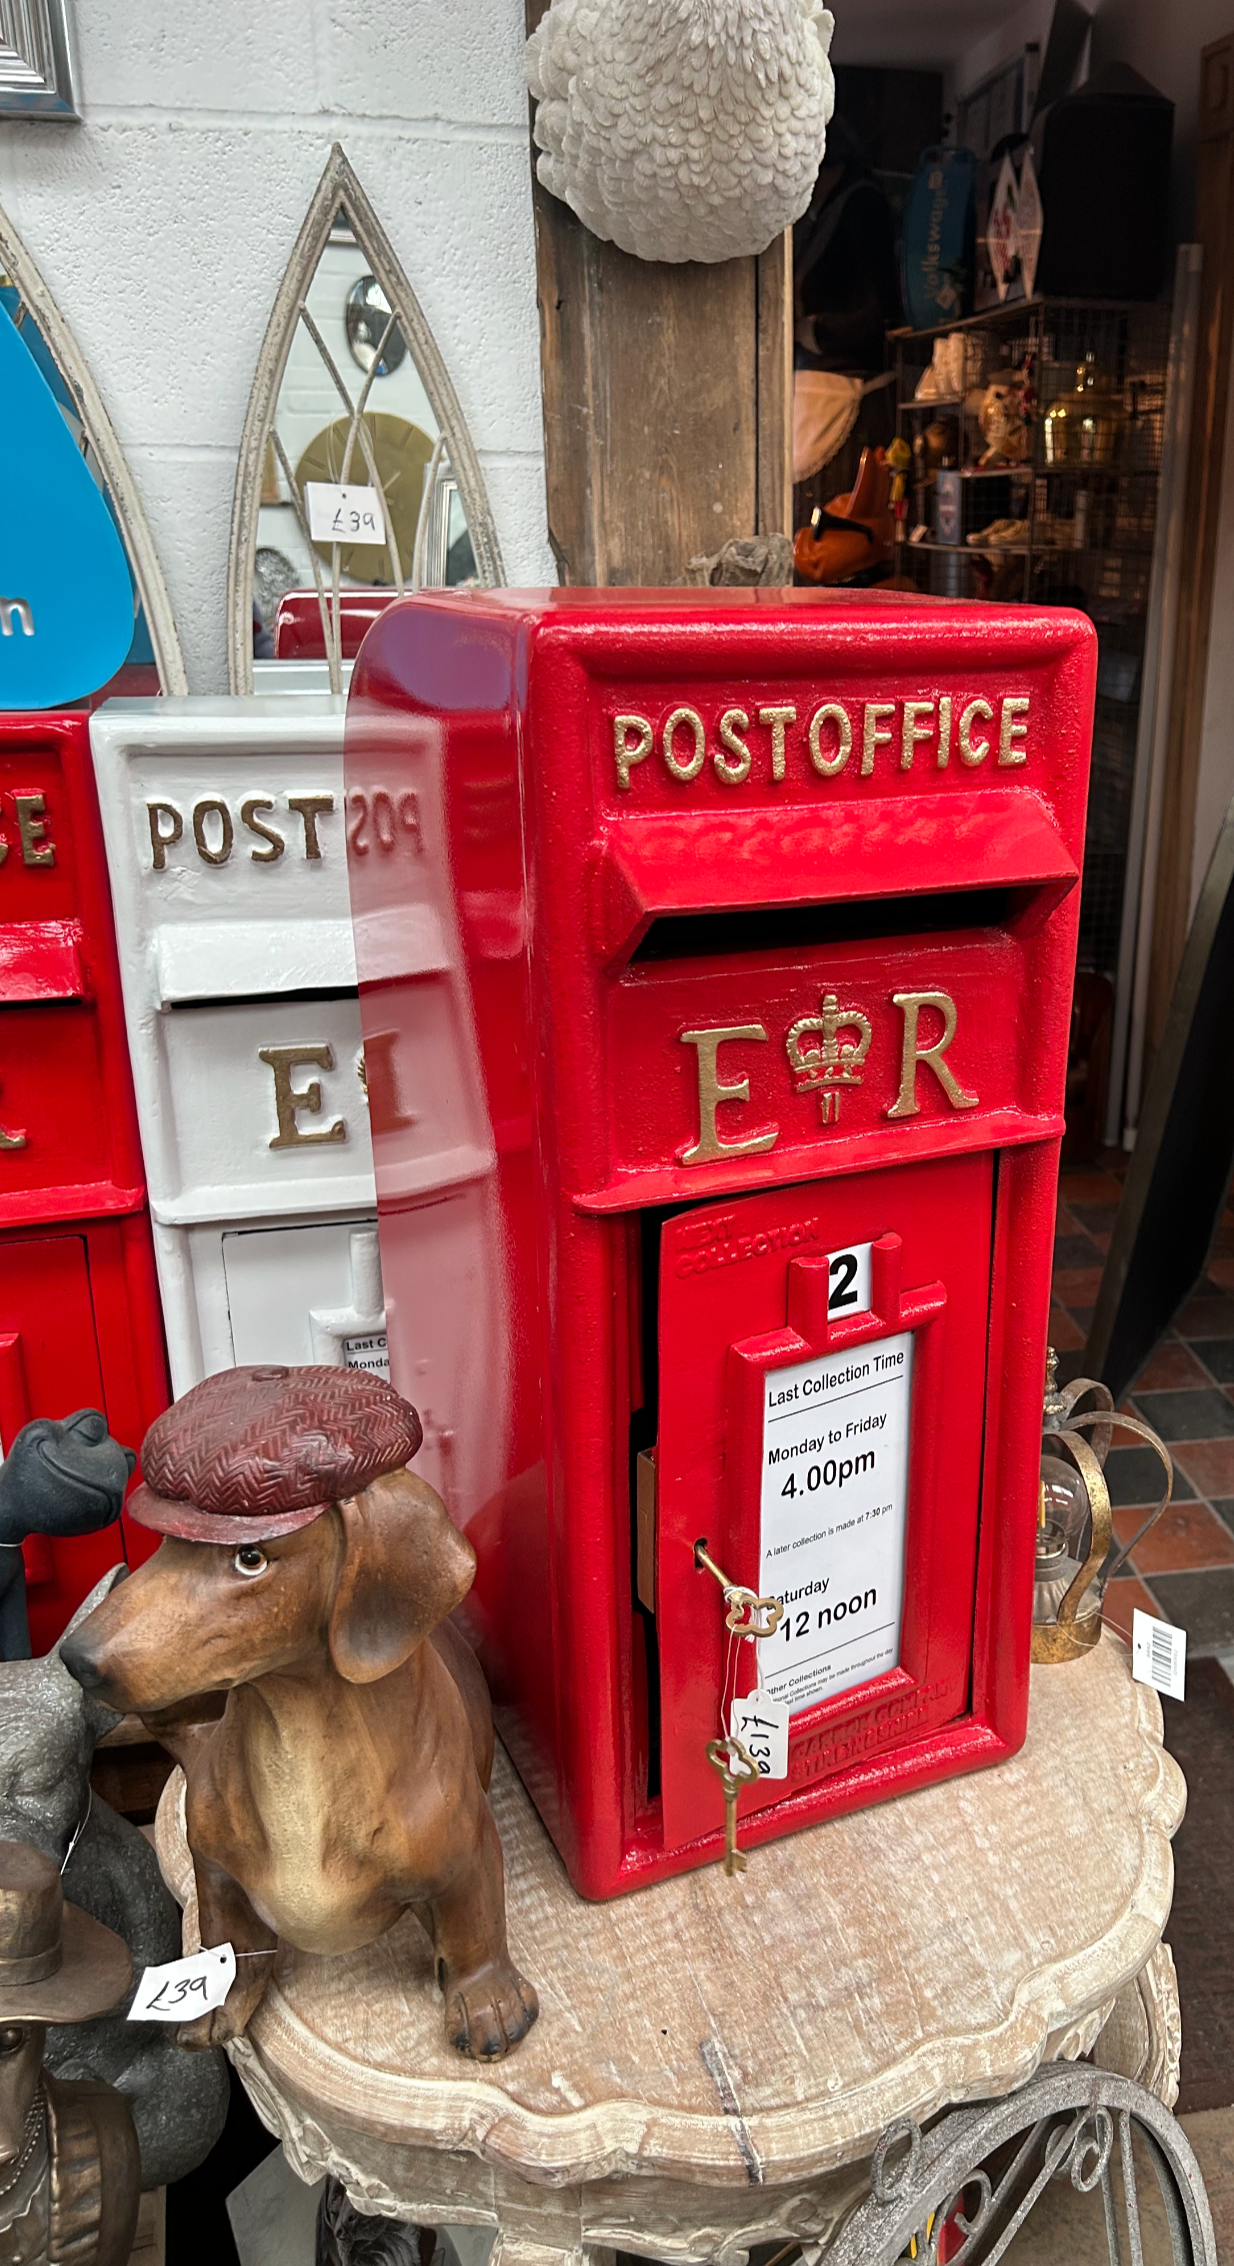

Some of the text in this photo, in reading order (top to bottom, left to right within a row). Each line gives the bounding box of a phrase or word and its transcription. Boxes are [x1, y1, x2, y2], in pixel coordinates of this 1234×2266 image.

[921, 181, 949, 299] Volkswage
[332, 508, 376, 534] £39
[147, 795, 334, 869] POST
[258, 1044, 346, 1149] E
[679, 1024, 779, 1165] E
[886, 991, 980, 1118] R
[675, 1217, 820, 1279] COLLECTION
[828, 1253, 859, 1310] 2
[346, 1337, 387, 1351] Last C
[348, 1357, 390, 1369] Monda
[768, 1352, 904, 1408] Last Collection Time
[768, 1413, 887, 1466] Monday to Friday
[781, 1450, 875, 1499] 4.00pm
[766, 1503, 893, 1559] A later collection is made at 7:30 pm
[780, 1588, 877, 1642] 12 noon
[788, 1664, 832, 1687] Collections
[741, 1715, 779, 1774] £139
[146, 1976, 208, 2011] £39
